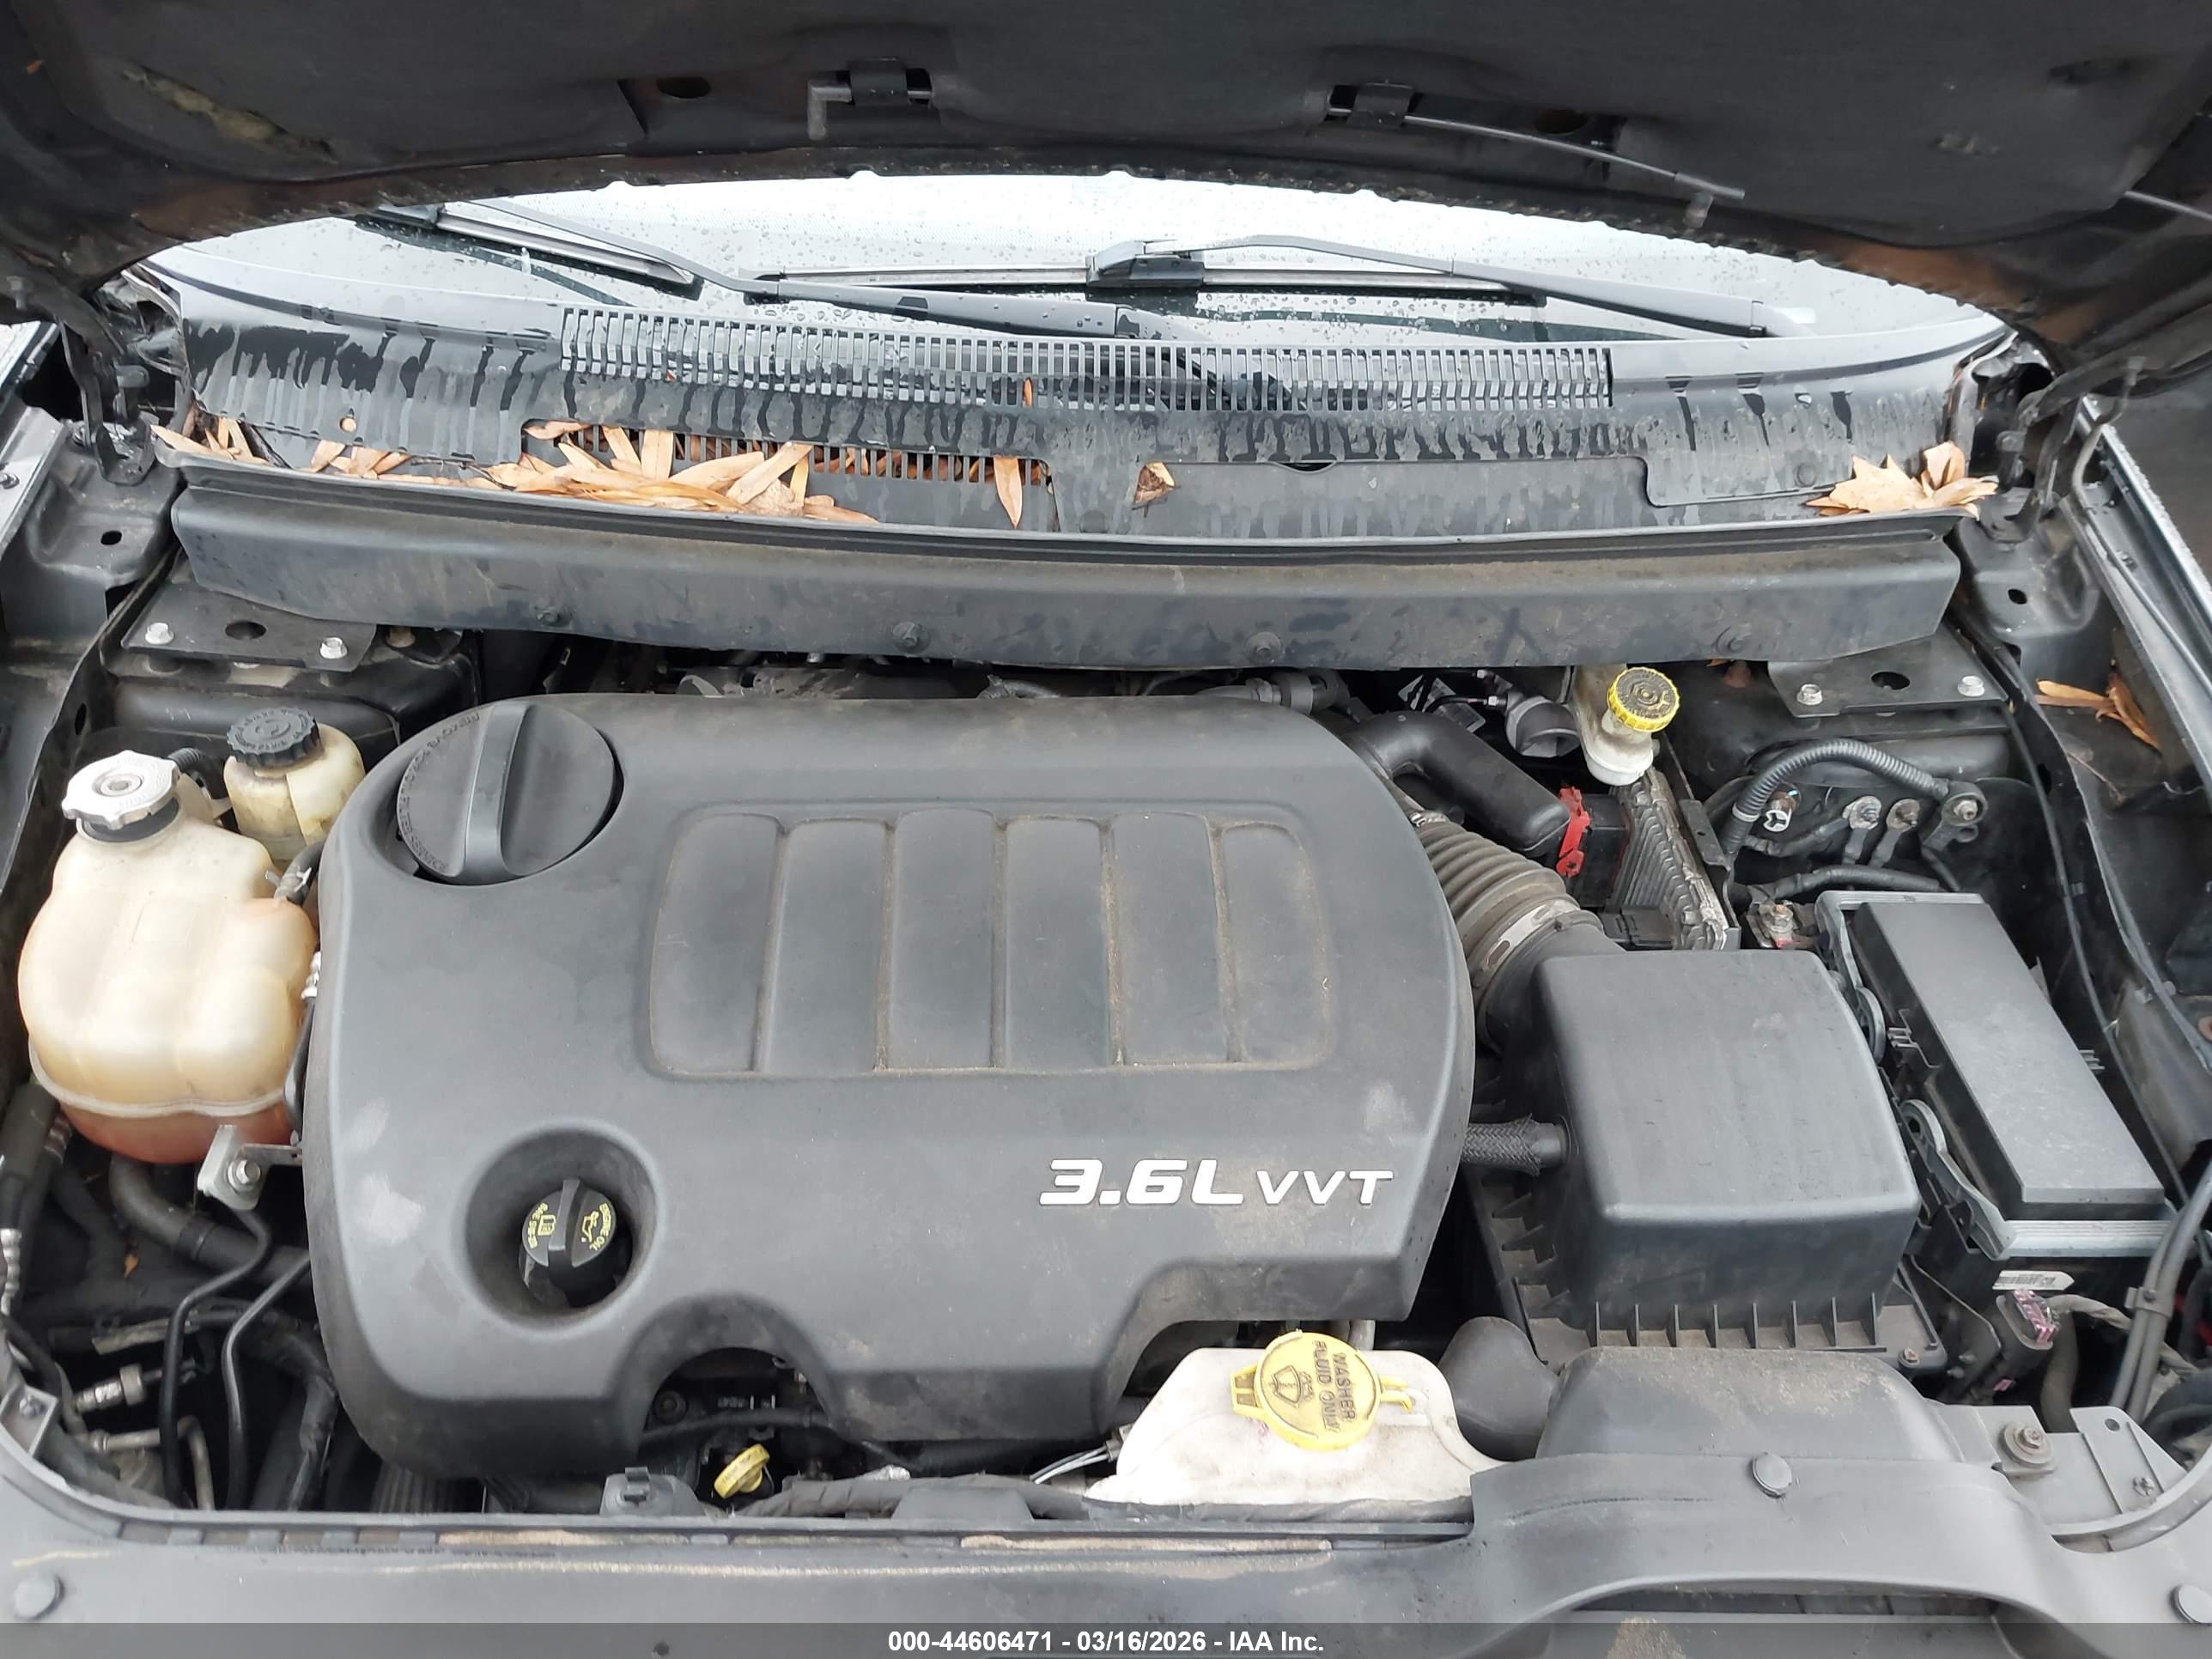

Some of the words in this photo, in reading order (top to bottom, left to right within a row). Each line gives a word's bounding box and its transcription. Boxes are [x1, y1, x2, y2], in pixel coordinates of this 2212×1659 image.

[1039, 1158, 1244, 1206] 3.6L
[1255, 1170, 1394, 1206] VVT
[1312, 1340, 1332, 1383] FLUID
[1333, 1352, 1356, 1421] WASHER
[1319, 1389, 1340, 1432] ONLY
